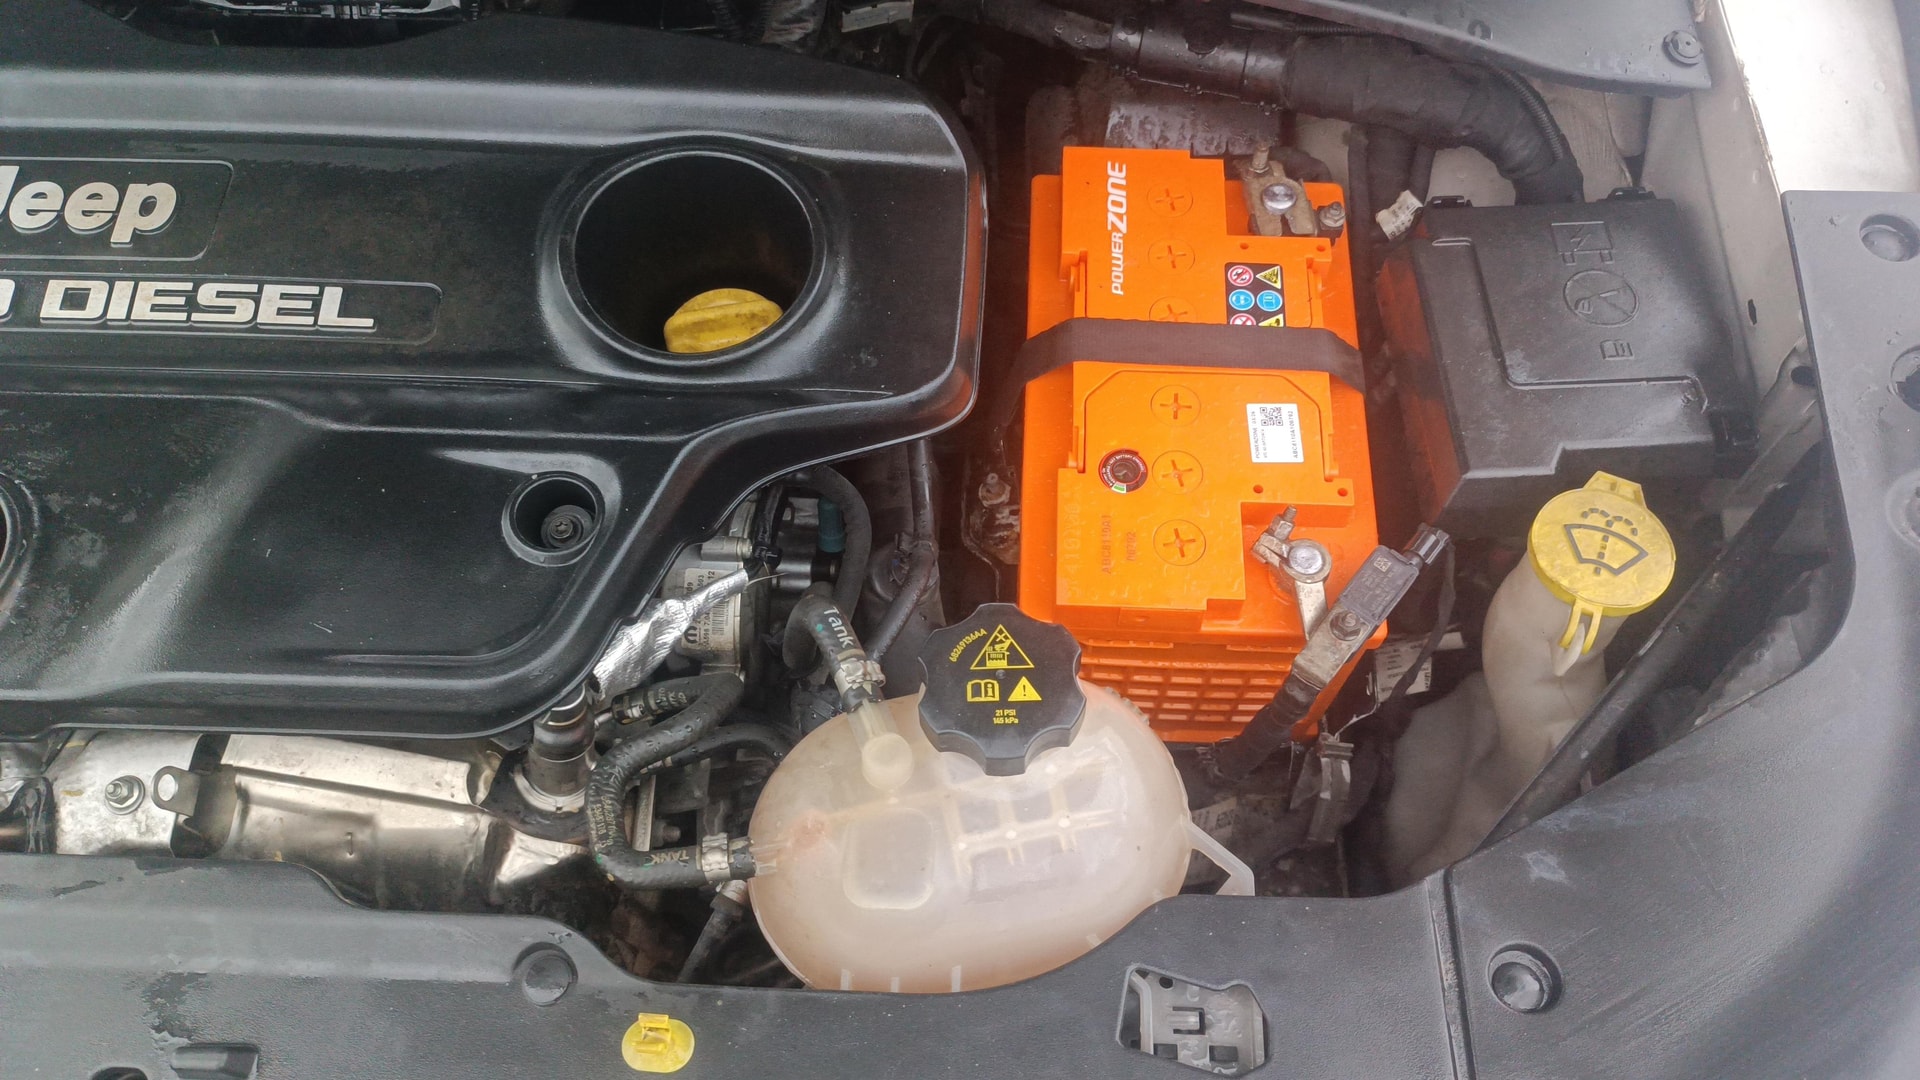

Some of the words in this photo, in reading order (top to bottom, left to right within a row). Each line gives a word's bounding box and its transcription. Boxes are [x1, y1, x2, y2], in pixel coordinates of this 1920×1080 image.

[40, 279, 375, 329] DIESEL
[824, 606, 854, 648] Tank
[650, 849, 690, 865] TANK
